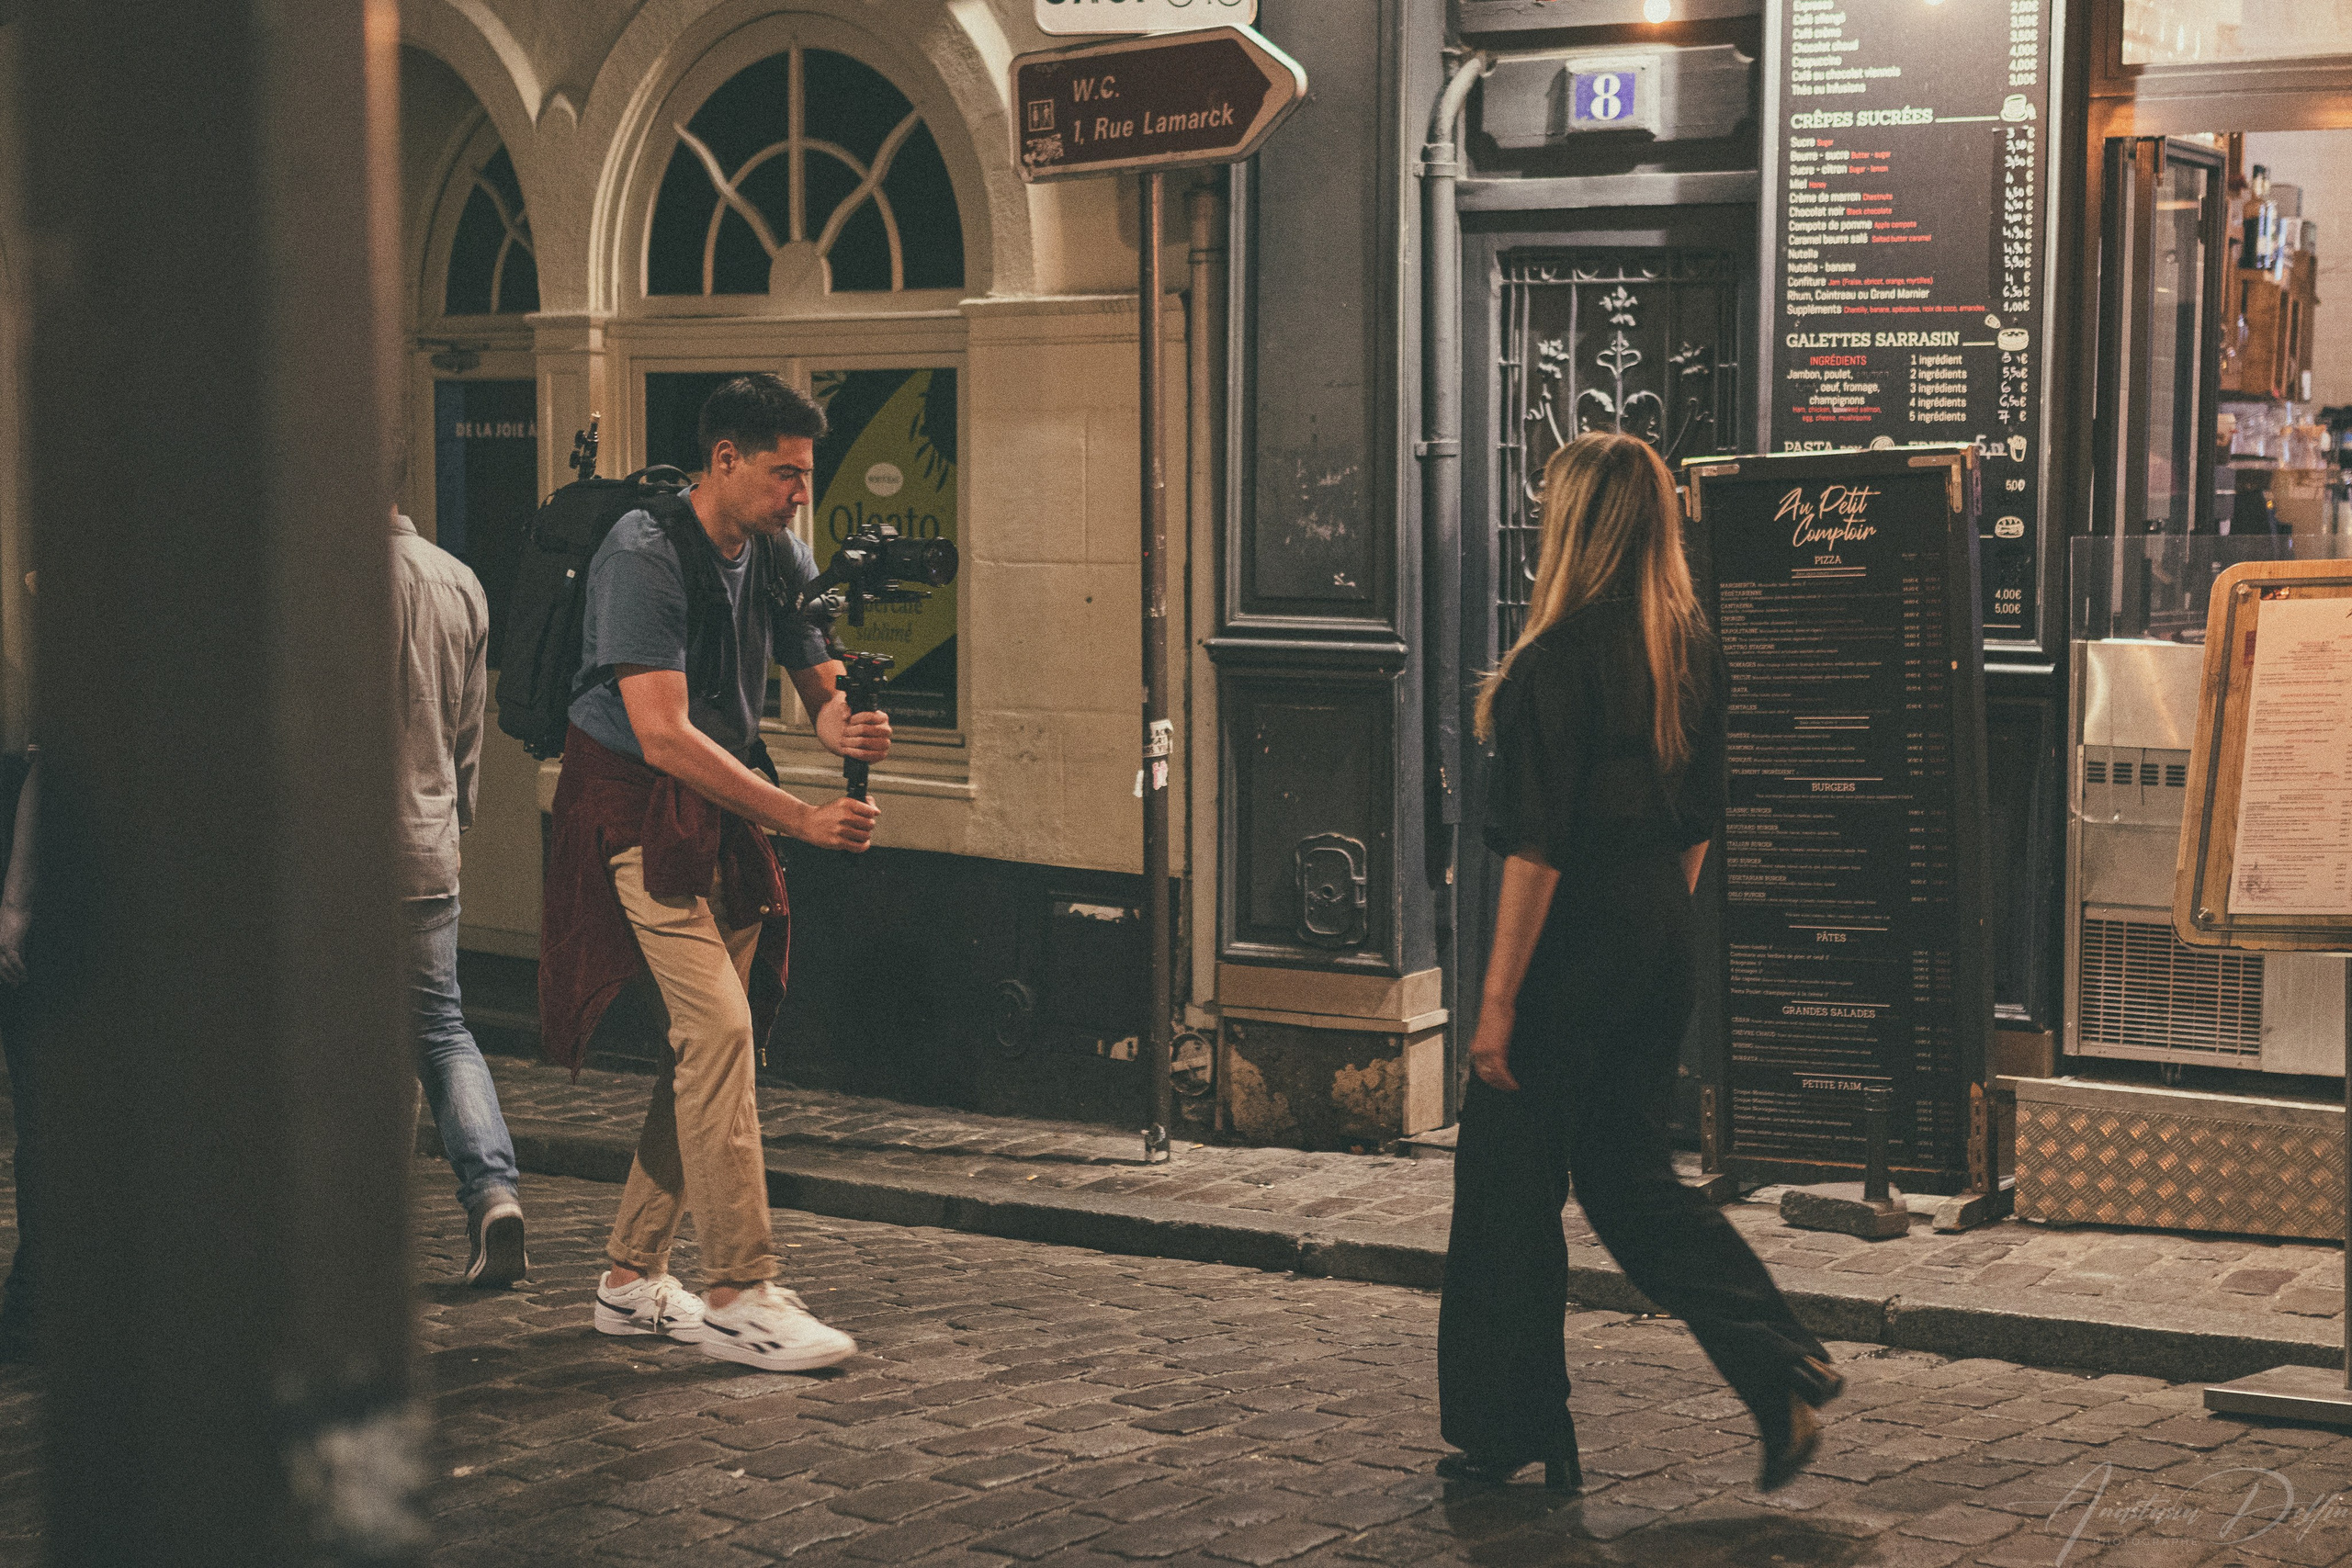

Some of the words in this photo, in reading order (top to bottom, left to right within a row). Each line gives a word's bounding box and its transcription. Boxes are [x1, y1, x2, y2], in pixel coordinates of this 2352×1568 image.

[1073, 76, 1120, 102] W.C.
[1590, 73, 1622, 120] 8
[1094, 118, 1134, 141] Rue
[1143, 103, 1235, 135] Lamarck
[1791, 108, 1854, 130] CRÊPES
[1856, 105, 1934, 127] SUCRÉES
[1790, 137, 1815, 148] Sucre
[1790, 150, 1819, 162] Beurre
[1825, 150, 1850, 161] sucre
[1790, 164, 1815, 175] Sucre
[1821, 164, 1849, 175] citron
[1789, 178, 1808, 189] Miel
[1789, 192, 1817, 204] Crème
[1818, 192, 1830, 203] de
[1788, 206, 1827, 218] Chocolat
[1827, 206, 1846, 217] noir
[1788, 220, 1827, 232] Compote
[1827, 220, 1839, 231] de
[1840, 220, 1872, 231] pomme
[1788, 233, 1822, 245] Caramel
[1823, 233, 1849, 244] beurre
[1850, 232, 1869, 244] salé
[1788, 249, 1819, 259] Nutella
[1787, 263, 1819, 273] Nutella
[1825, 262, 1857, 273] banane
[1787, 276, 1826, 288] Confiture
[1787, 289, 1814, 302] Rhum,
[1815, 289, 1857, 301] Cointreau
[1858, 290, 1869, 299] ou
[1870, 288, 1895, 299] Grand
[1897, 288, 1930, 299] Marnier
[1787, 304, 1843, 317] Suppléments
[1786, 332, 1871, 348] GALETTES
[1874, 331, 1961, 347] SARRASIN
[1809, 354, 1868, 366] INGRÉDIENTS
[1910, 355, 1917, 365] 1
[1918, 354, 1962, 367] ingrédient
[1787, 370, 1823, 381] Jambon,
[1824, 369, 1854, 381] poulet,
[1909, 369, 1917, 379] 2
[1917, 368, 1968, 382] ingrédients
[1820, 381, 1841, 393] oeuf,
[1843, 382, 1881, 394] fromage,
[1909, 383, 1917, 394] 3
[1917, 382, 1968, 396] ingrédients
[1809, 396, 1866, 407] champignons
[1909, 398, 1917, 408] 4
[1917, 397, 1967, 411] ingrédients
[1909, 412, 1917, 422] 5
[1917, 411, 1967, 424] ingrédients
[456, 422, 472, 437] DE
[476, 422, 492, 437] LA
[497, 422, 525, 437] JOIE
[1774, 488, 1814, 521] Au
[1819, 485, 1882, 519] Petit
[1792, 513, 1877, 551] Comptoir
[1815, 556, 1842, 565] PIZZA
[1995, 589, 2022, 600] 4,00€
[1995, 603, 2021, 614] 5,00€
[1811, 783, 1856, 792] BURGERS
[1816, 931, 1847, 942] PÂTES
[1782, 1006, 1828, 1016] GRANDES
[1830, 1008, 1876, 1019] SALADES
[1803, 1079, 1834, 1089] PETITE
[1838, 1080, 1861, 1091] FAIM
